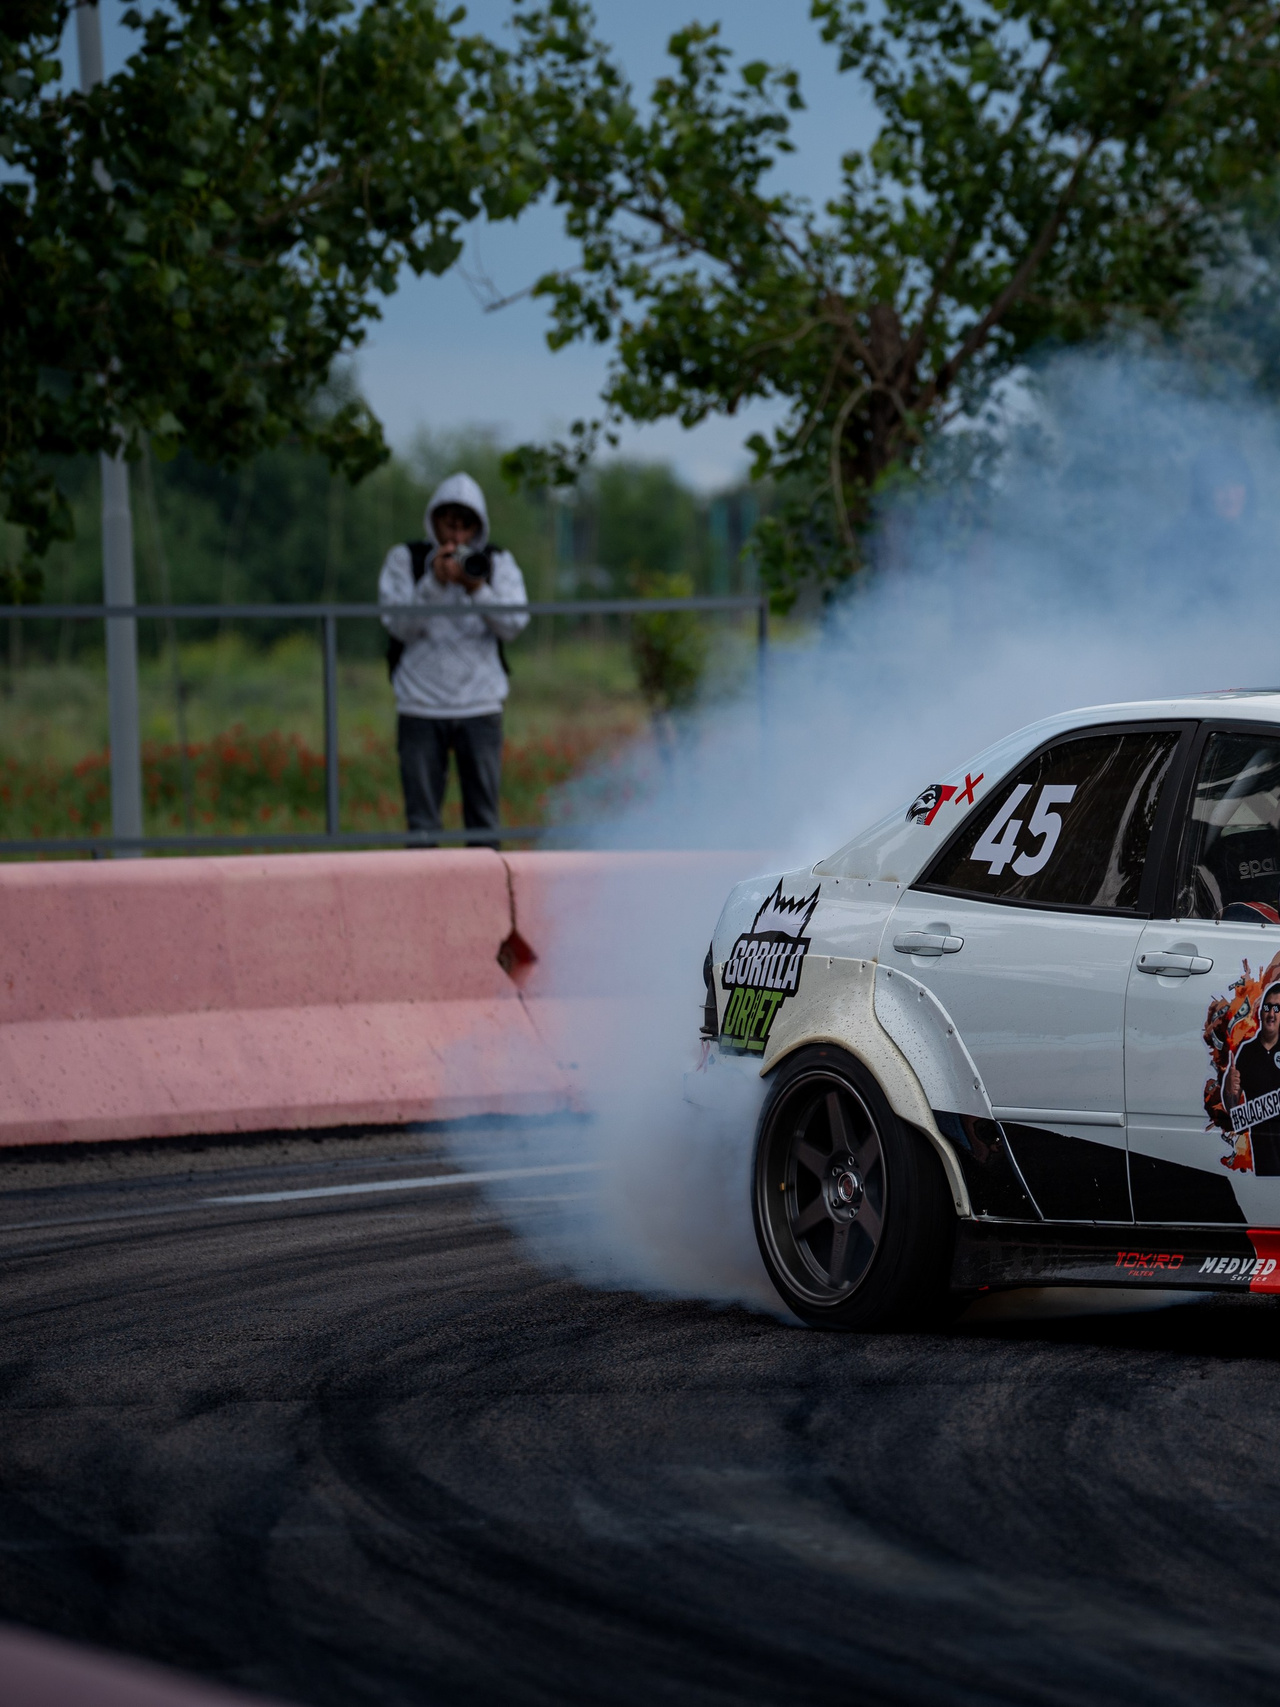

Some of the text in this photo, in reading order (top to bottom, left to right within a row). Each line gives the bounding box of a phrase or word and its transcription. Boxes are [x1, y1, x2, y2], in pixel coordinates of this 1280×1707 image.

[970, 783, 1078, 876] 45
[724, 939, 806, 990] GORILLA
[723, 987, 785, 1049] DRIFT
[1115, 1251, 1185, 1270] TOKIRO
[1198, 1257, 1277, 1276] MEDVED
[1230, 1274, 1268, 1282] Service
